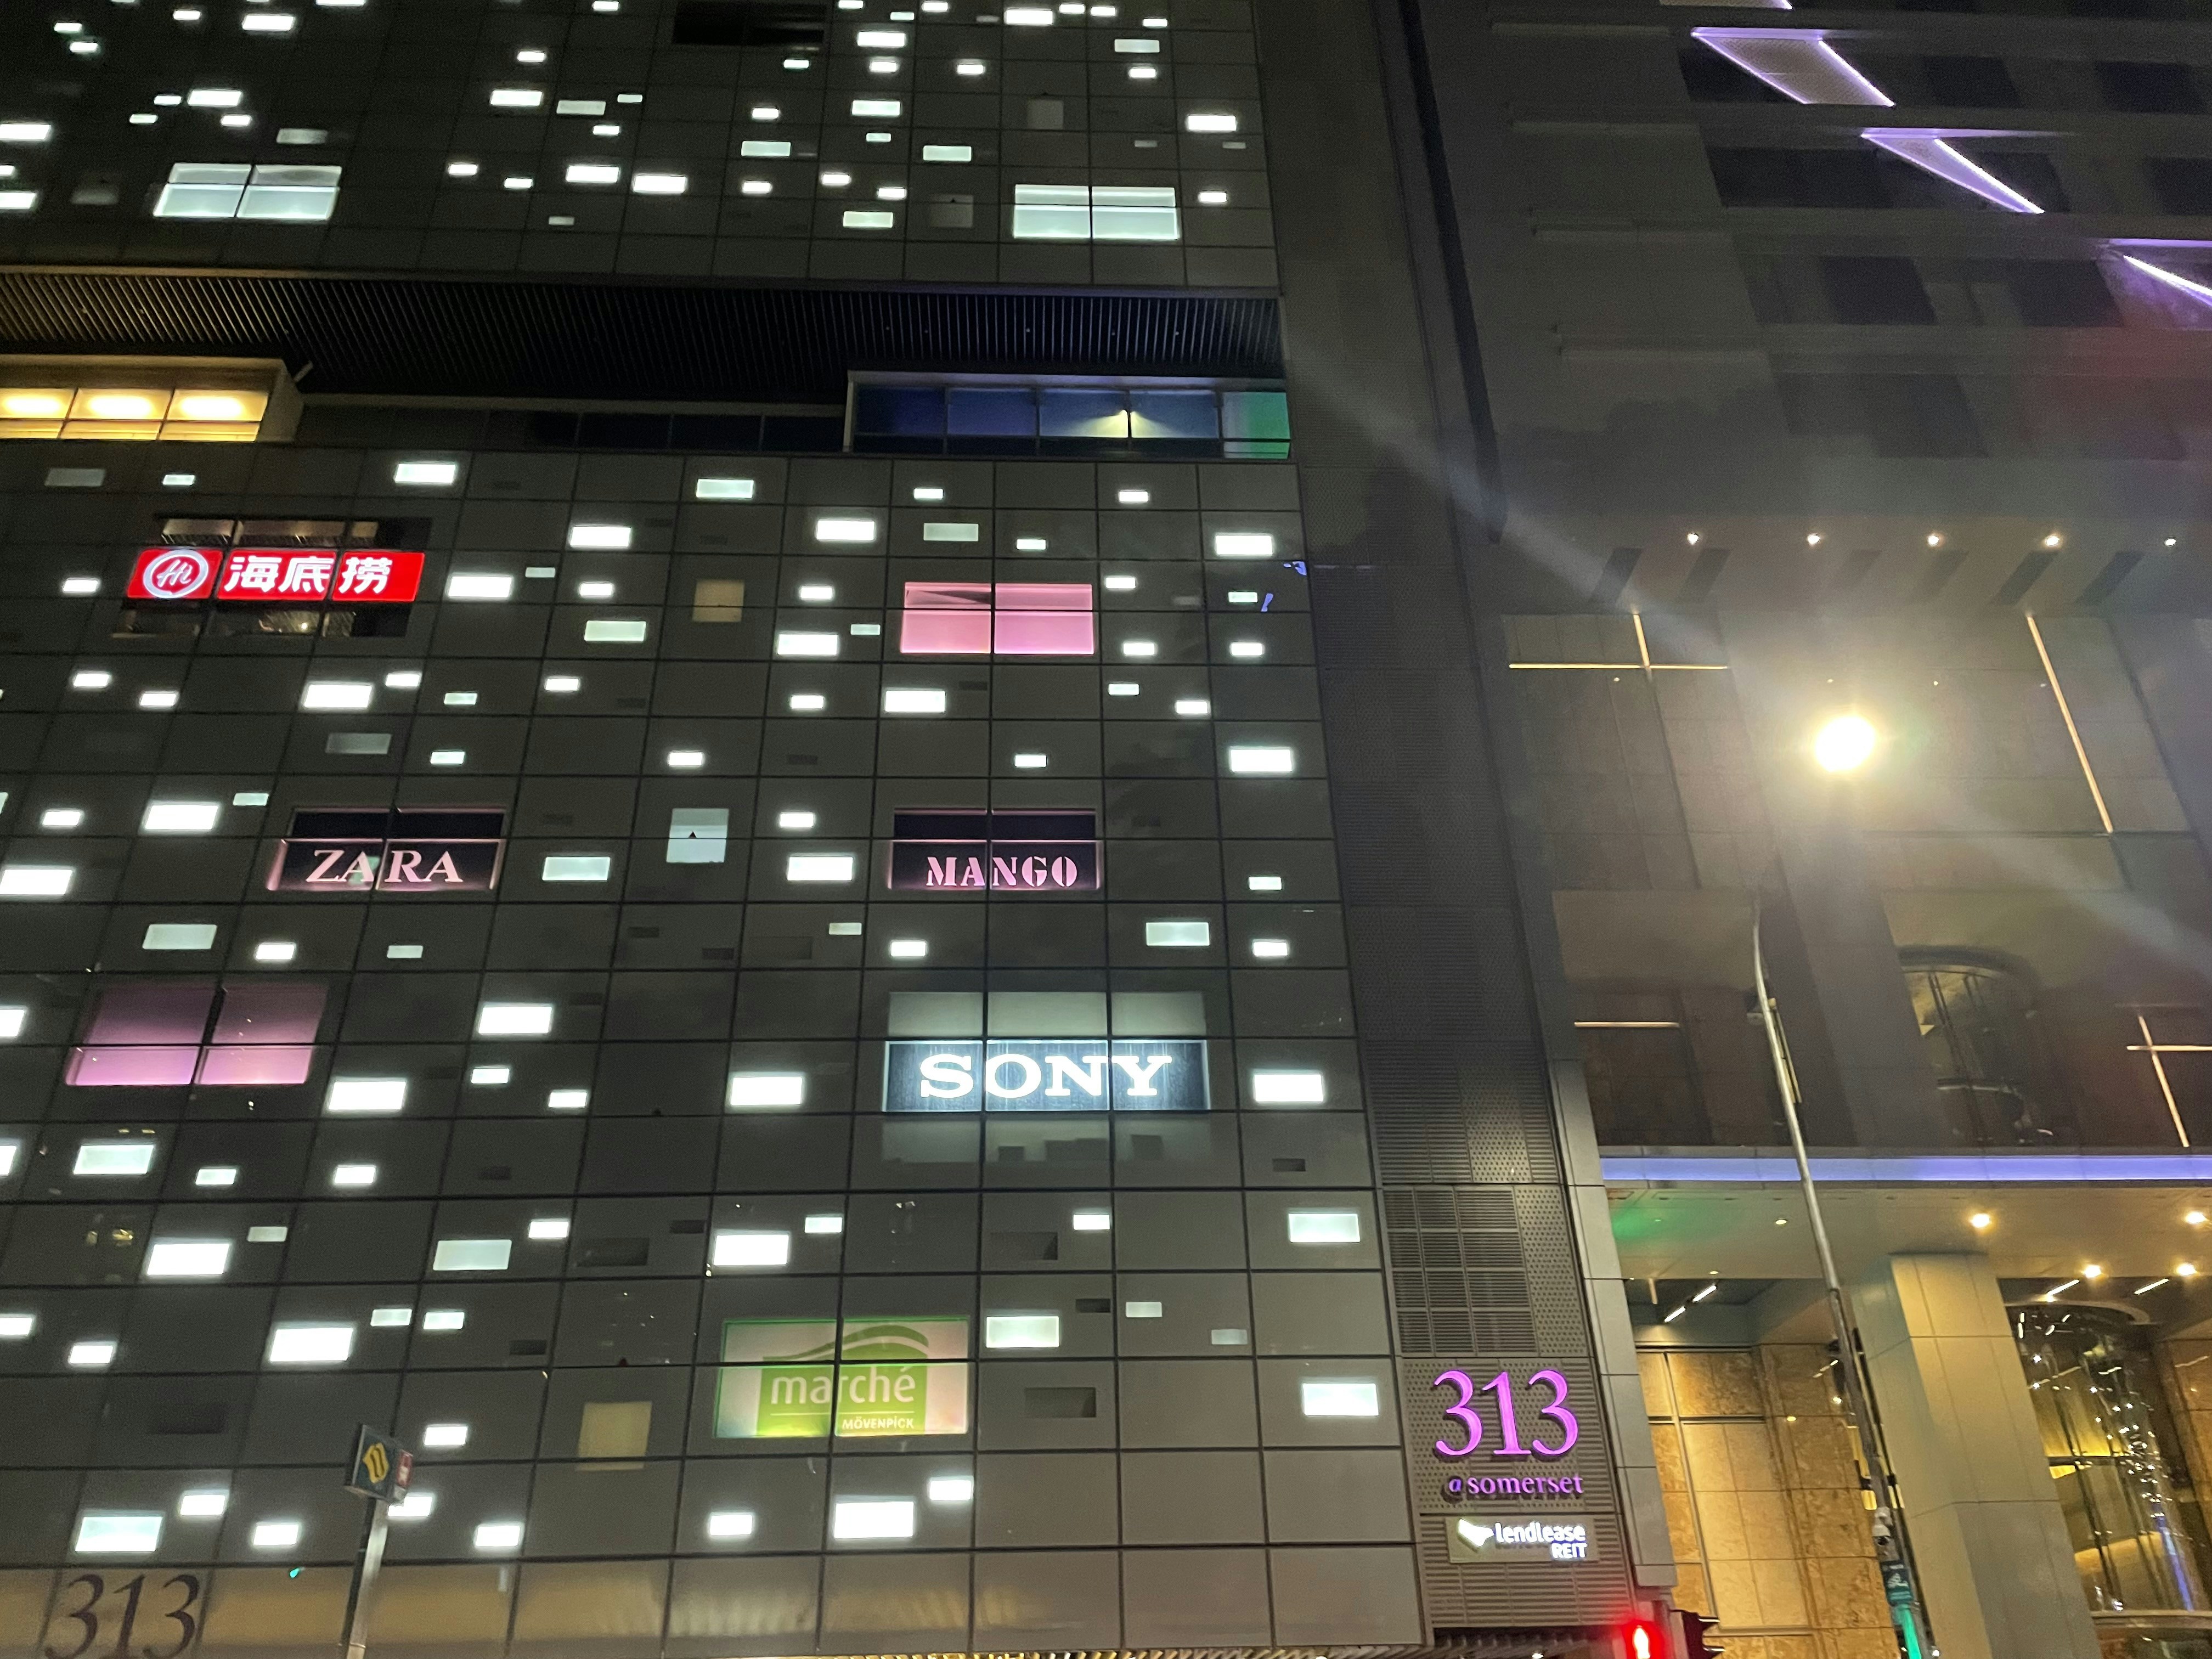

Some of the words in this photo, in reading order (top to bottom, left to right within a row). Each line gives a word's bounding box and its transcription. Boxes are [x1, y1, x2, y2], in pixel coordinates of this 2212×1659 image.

[224, 556, 393, 594] 海底捞
[305, 850, 464, 883] ZARA
[926, 856, 1077, 887] MANGO
[919, 1053, 1172, 1098] SONY
[1434, 1369, 1578, 1456] 313
[1494, 1522, 1587, 1543] lendlease
[1551, 1543, 1587, 1559] REIT
[44, 1574, 200, 1659] 313
